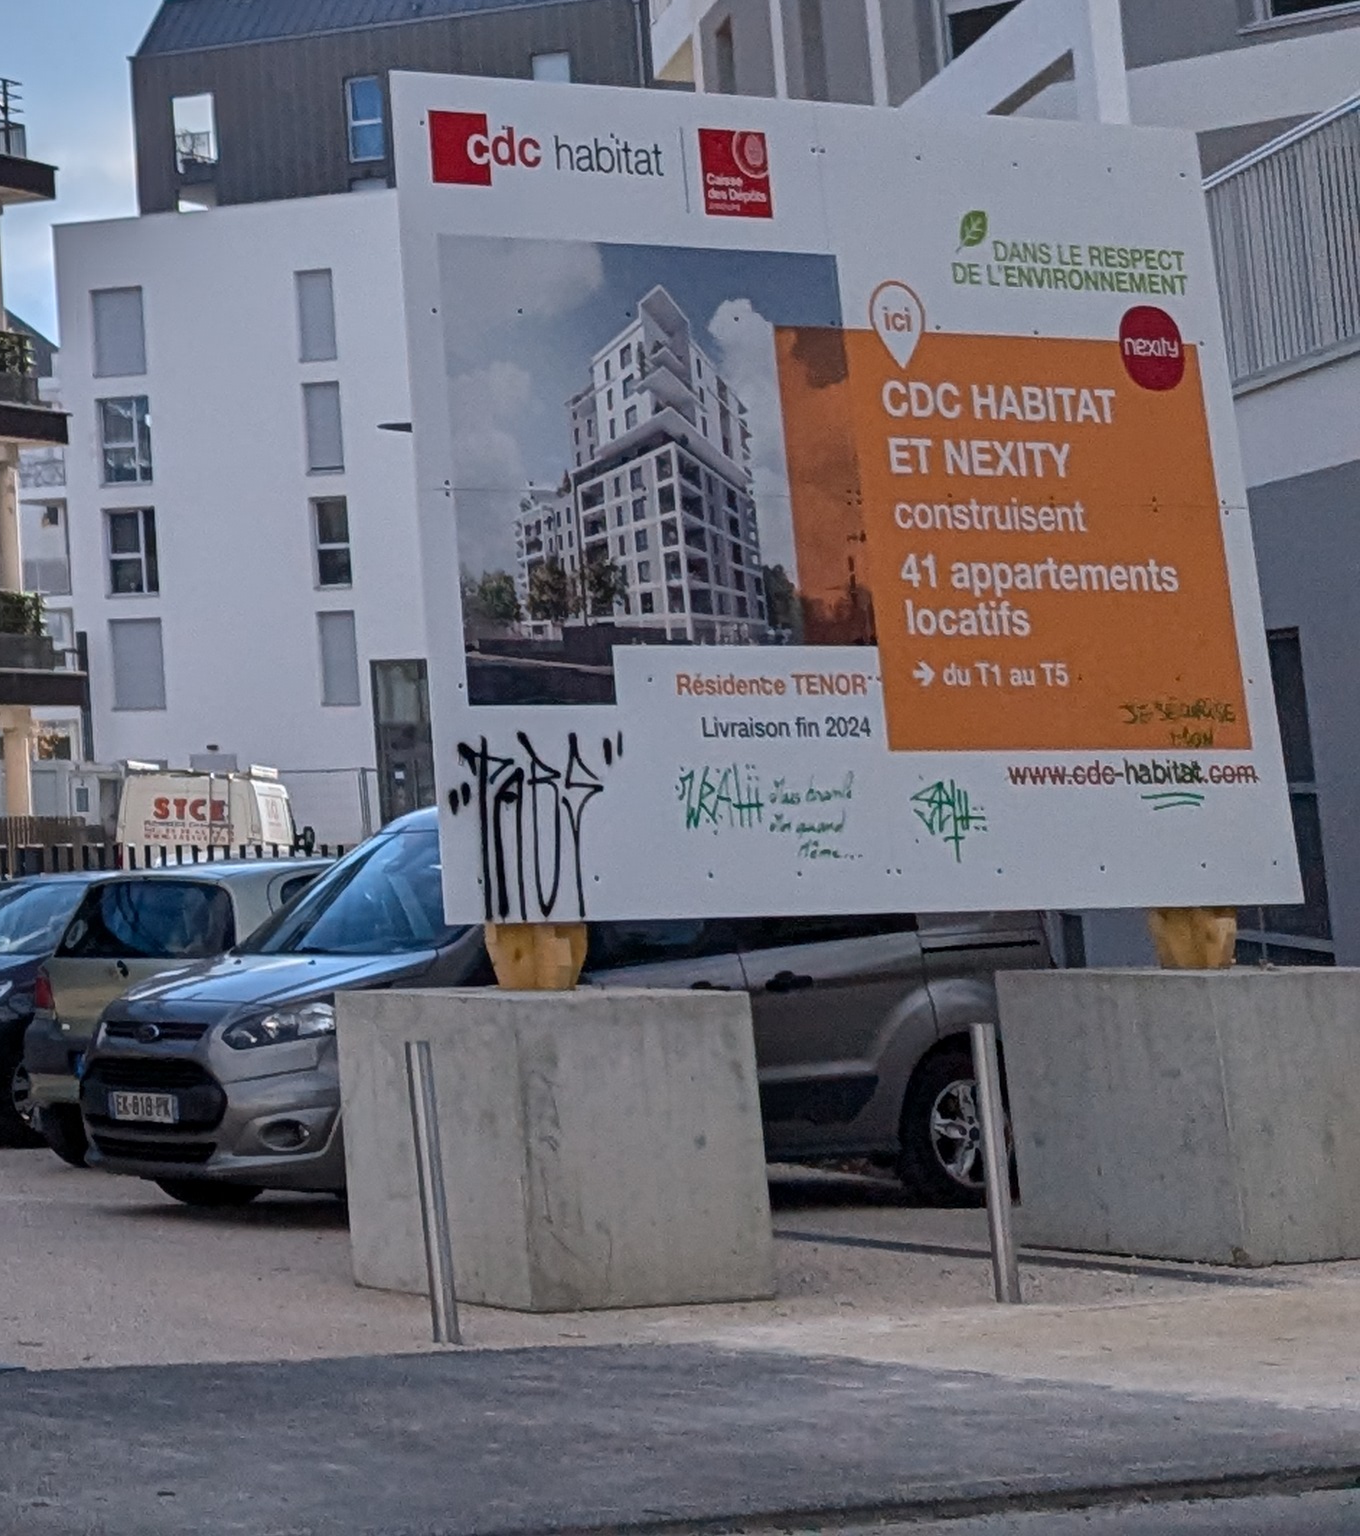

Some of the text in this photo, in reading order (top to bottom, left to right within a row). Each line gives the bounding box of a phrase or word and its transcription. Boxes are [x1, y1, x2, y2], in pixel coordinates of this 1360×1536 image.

[465, 124, 665, 177] cdc habitat
[992, 240, 1185, 272] DANS LE RESPECT
[951, 262, 1188, 296] DE L'ENVIRONNEMENT
[882, 306, 913, 332] ici
[1124, 337, 1179, 358] nexity
[882, 380, 1116, 424] CDC HABITAT
[888, 438, 1070, 478] ET NEXITY
[894, 497, 1088, 533] construisent
[901, 553, 1179, 597] 41 appartements
[905, 599, 1032, 637] locatifs
[676, 672, 868, 696] Résidence TENOR
[942, 663, 1069, 687] du T1 au T5
[701, 716, 872, 738] Livraison fin 2024
